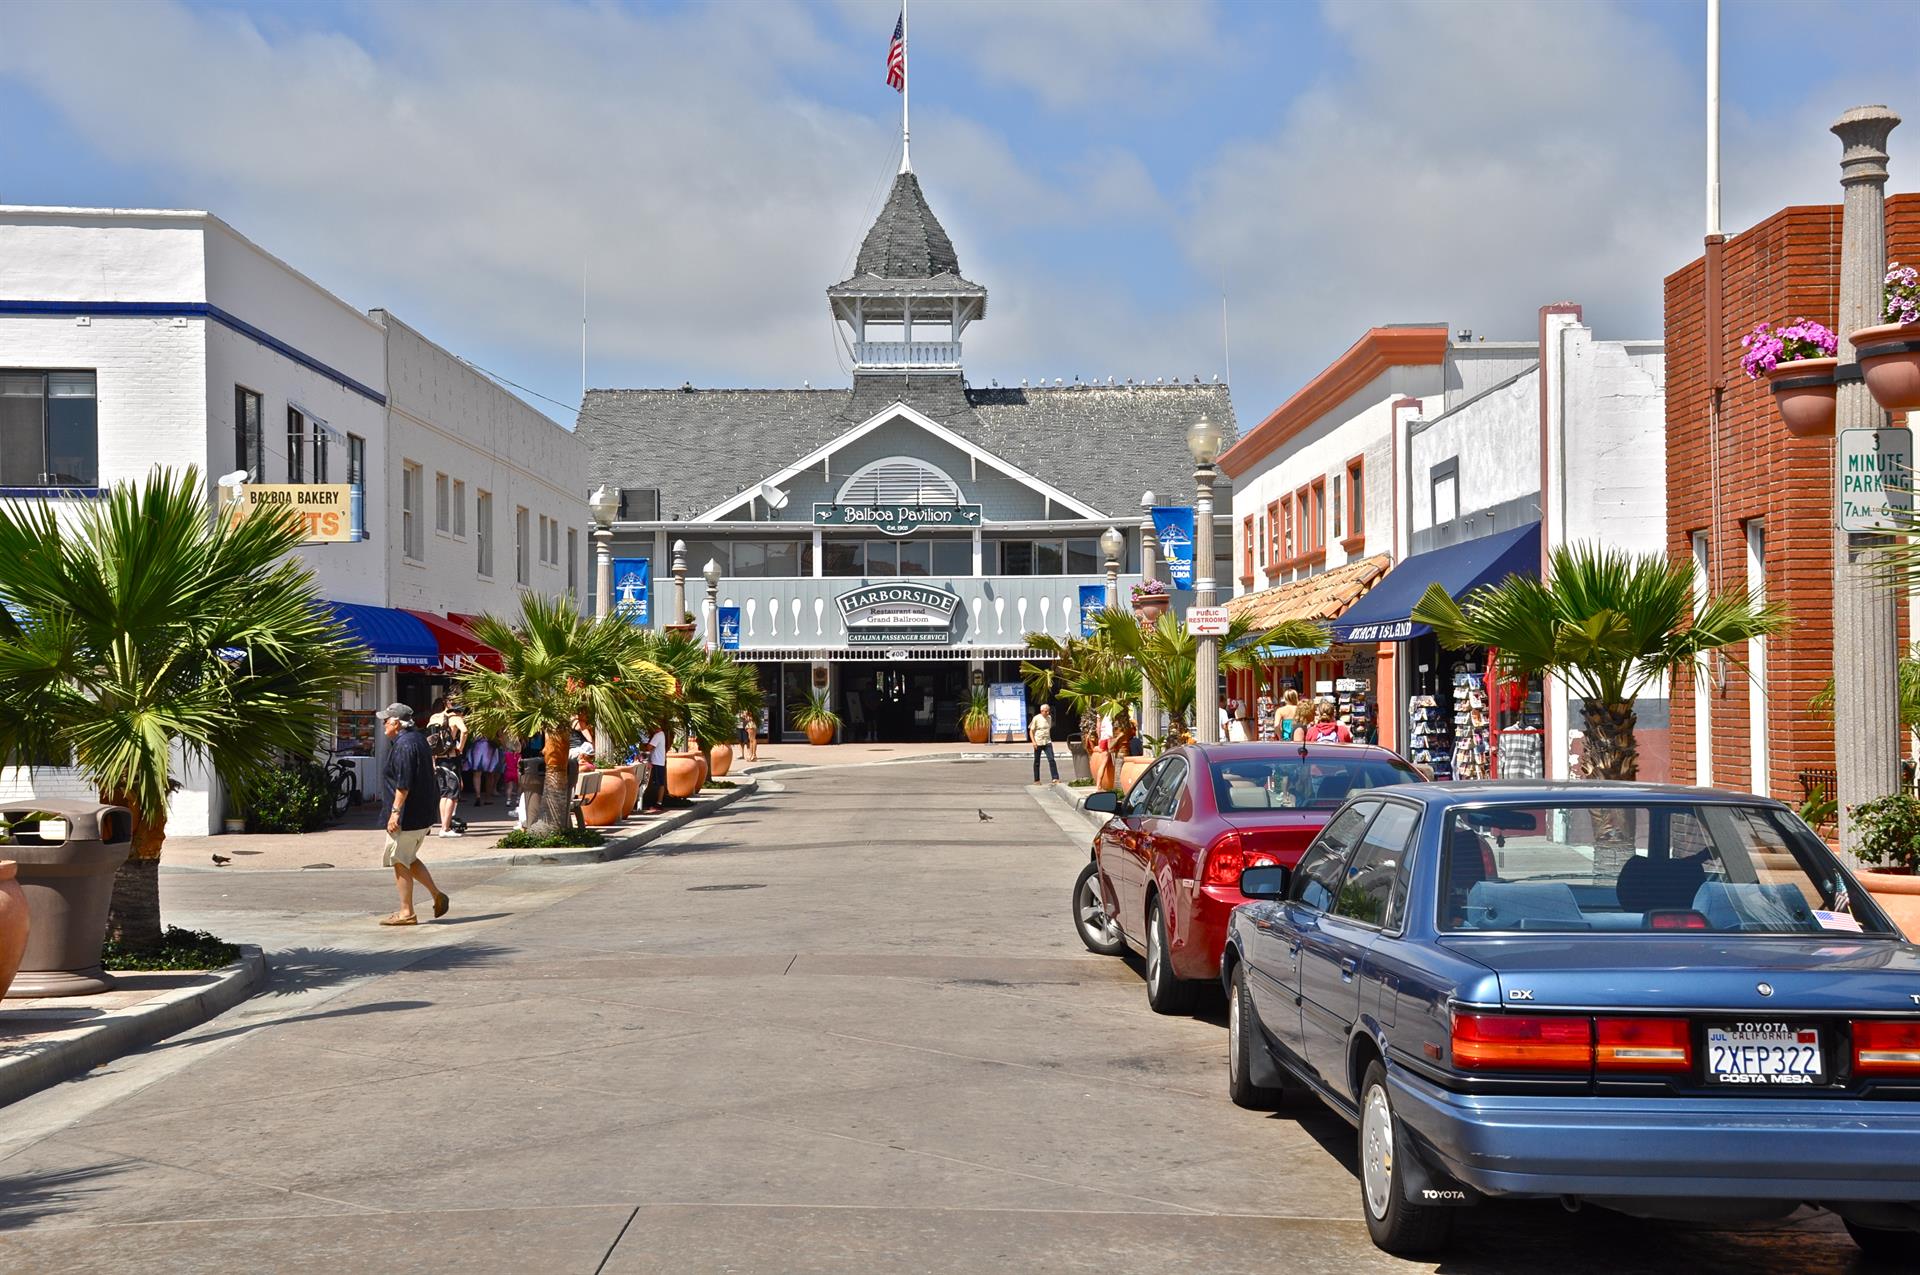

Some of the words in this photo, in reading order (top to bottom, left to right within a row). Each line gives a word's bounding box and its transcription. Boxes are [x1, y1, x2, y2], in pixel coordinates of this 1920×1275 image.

[1872, 433, 1881, 451] 3
[1848, 453, 1904, 472] MINUTE
[1844, 474, 1910, 493] PARKING
[250, 491, 292, 505] BALBOA
[297, 491, 340, 505] BAKERY
[844, 506, 894, 522] Balboa
[897, 507, 953, 524] Pavilion
[843, 589, 953, 611] HARBORSIDE
[1348, 626, 1379, 640] BEACH
[1378, 620, 1412, 639] ISLAND
[1509, 989, 1534, 1000] DX
[1711, 1033, 1728, 1041] JUL
[1732, 1031, 1793, 1040] CALIFORNIA
[1736, 1022, 1789, 1032] TOYOTA
[1714, 1045, 1817, 1074] 2XFP322
[1720, 1074, 1768, 1083] COSTA
[1770, 1074, 1813, 1083] MESA
[1422, 1189, 1465, 1199] TOYOTA
